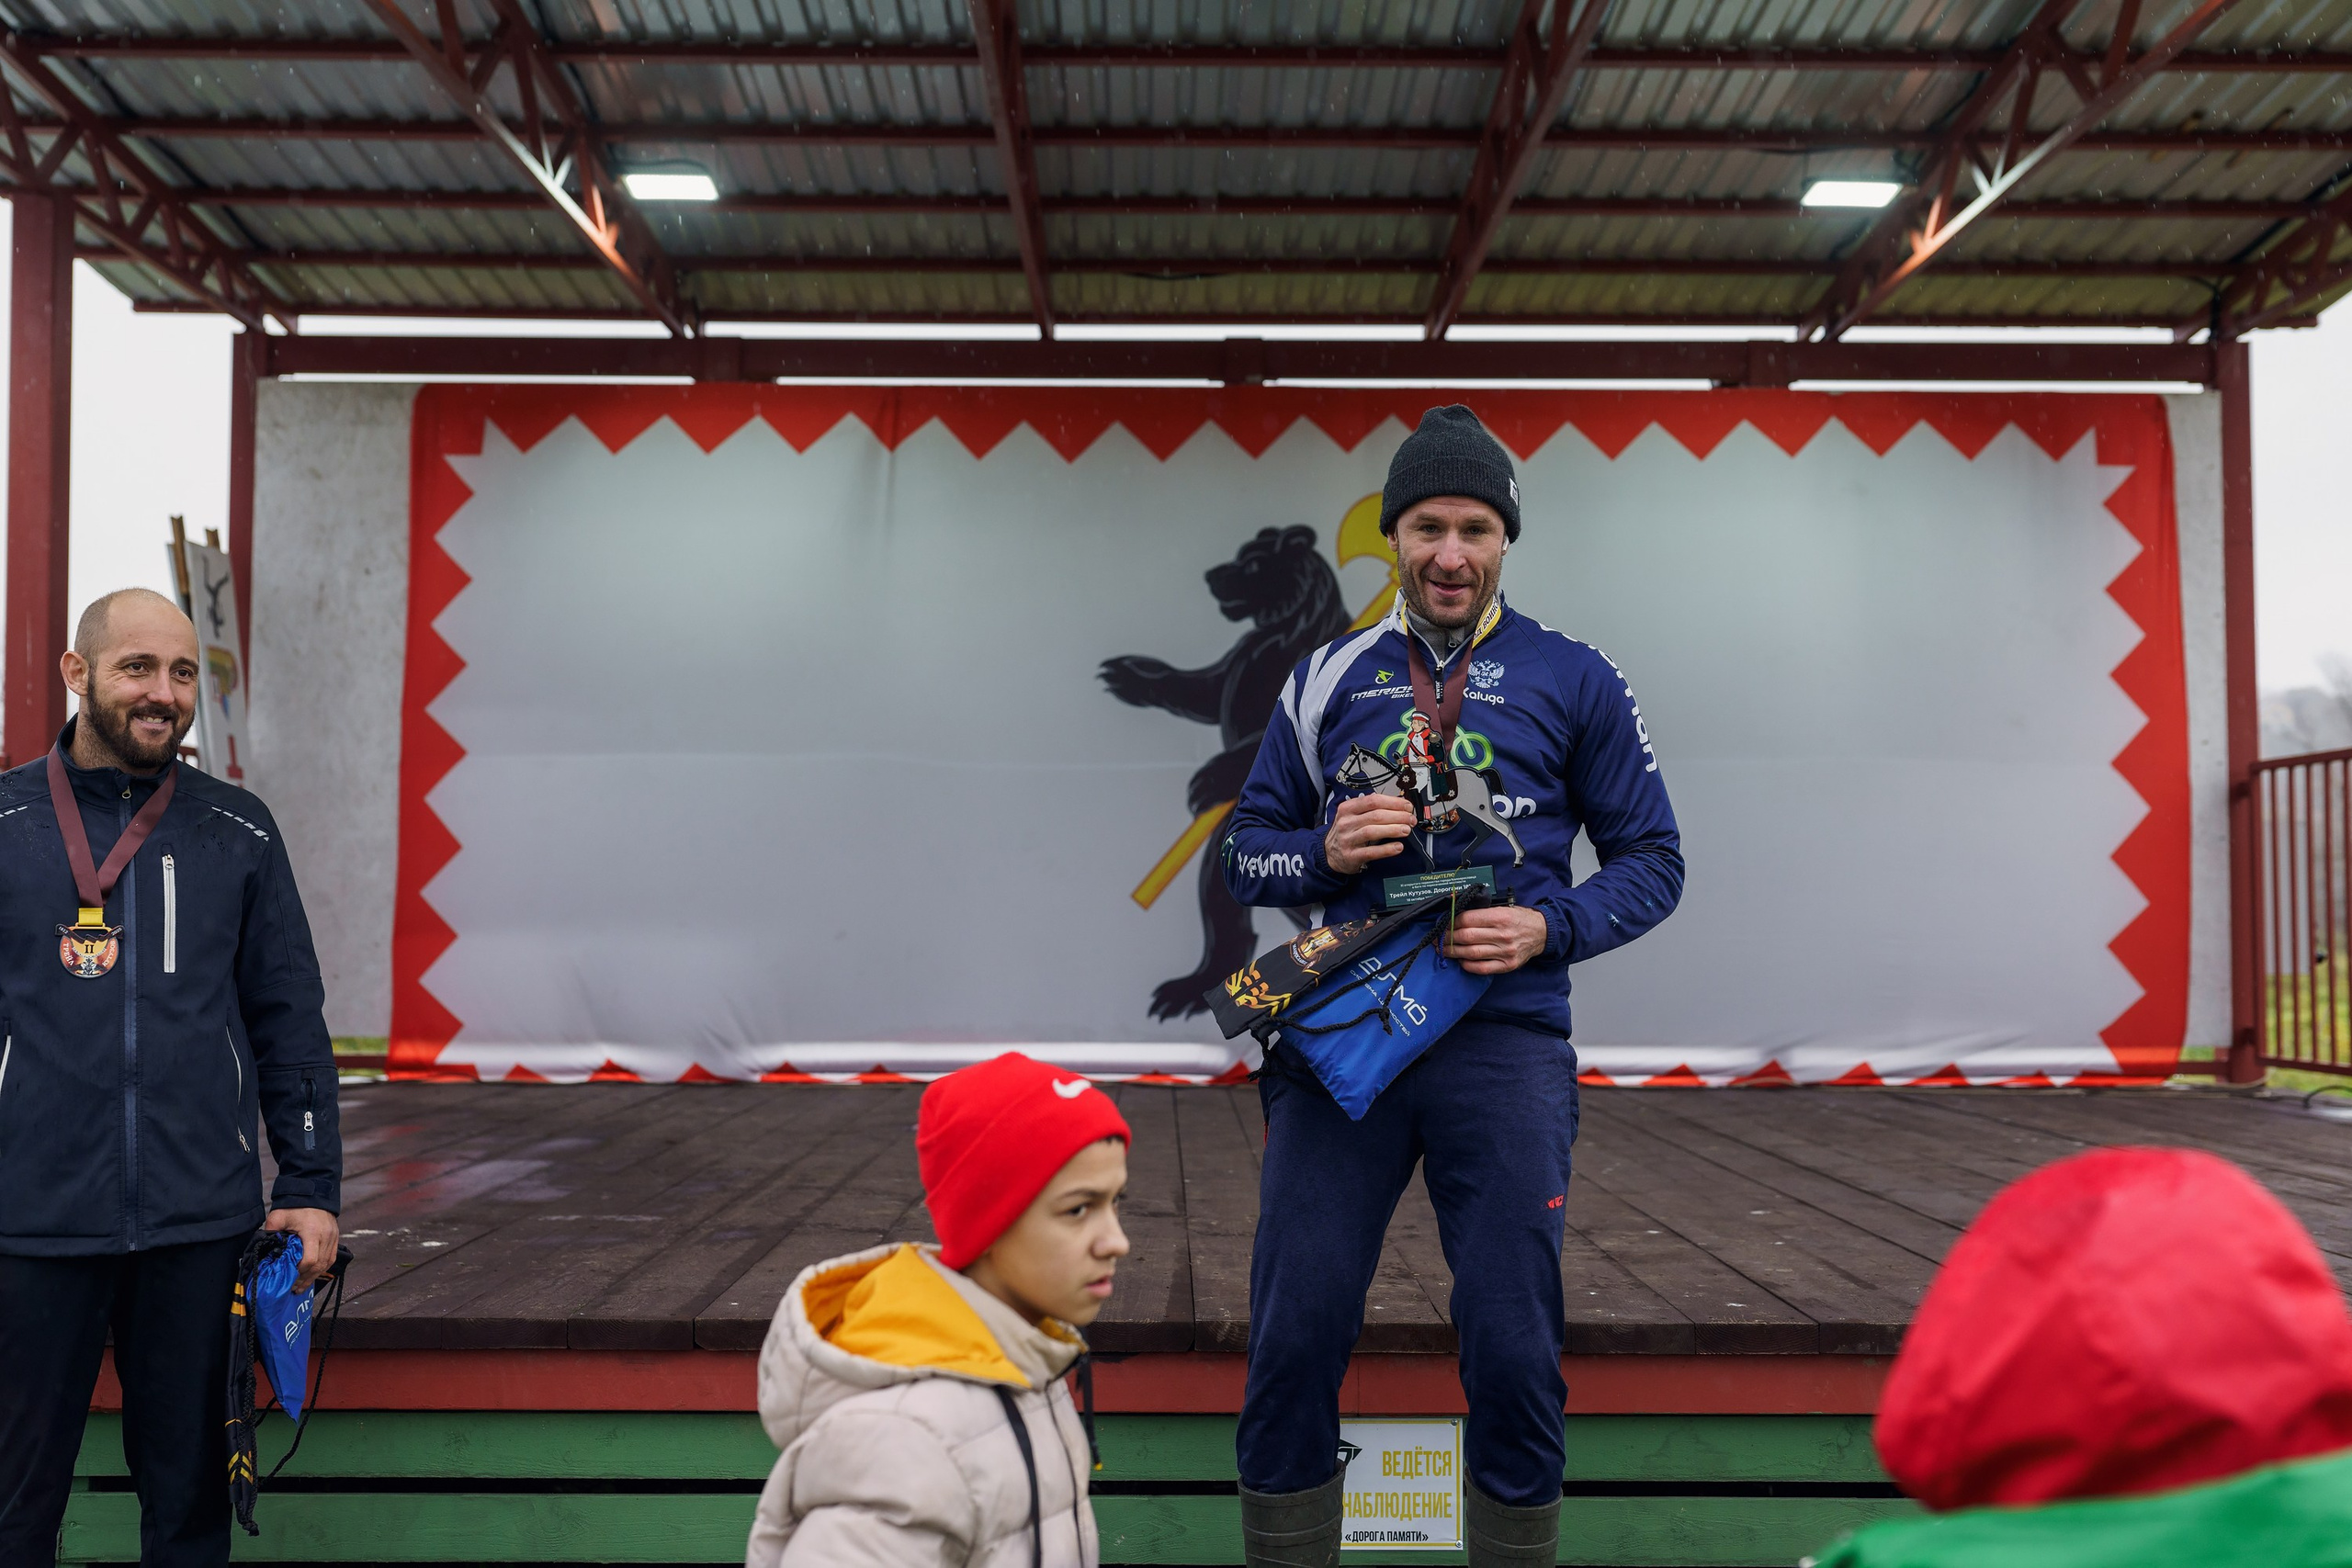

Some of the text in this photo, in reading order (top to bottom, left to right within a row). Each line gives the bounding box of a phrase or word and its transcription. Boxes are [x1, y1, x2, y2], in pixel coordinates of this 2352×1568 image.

[1420, 873, 1455, 881] ПОБЕДИТЕЛЮ
[62, 942, 74, 966] ТРЕЙЛ
[1350, 969, 1377, 998] СИСЕМА
[1382, 1446, 1452, 1480] ВЕДЁТСЯ
[1342, 1492, 1453, 1521] НАБЛЮДЕНИЕ
[1345, 1530, 1429, 1543] «ДОРОГА ПАМЯТИ»
